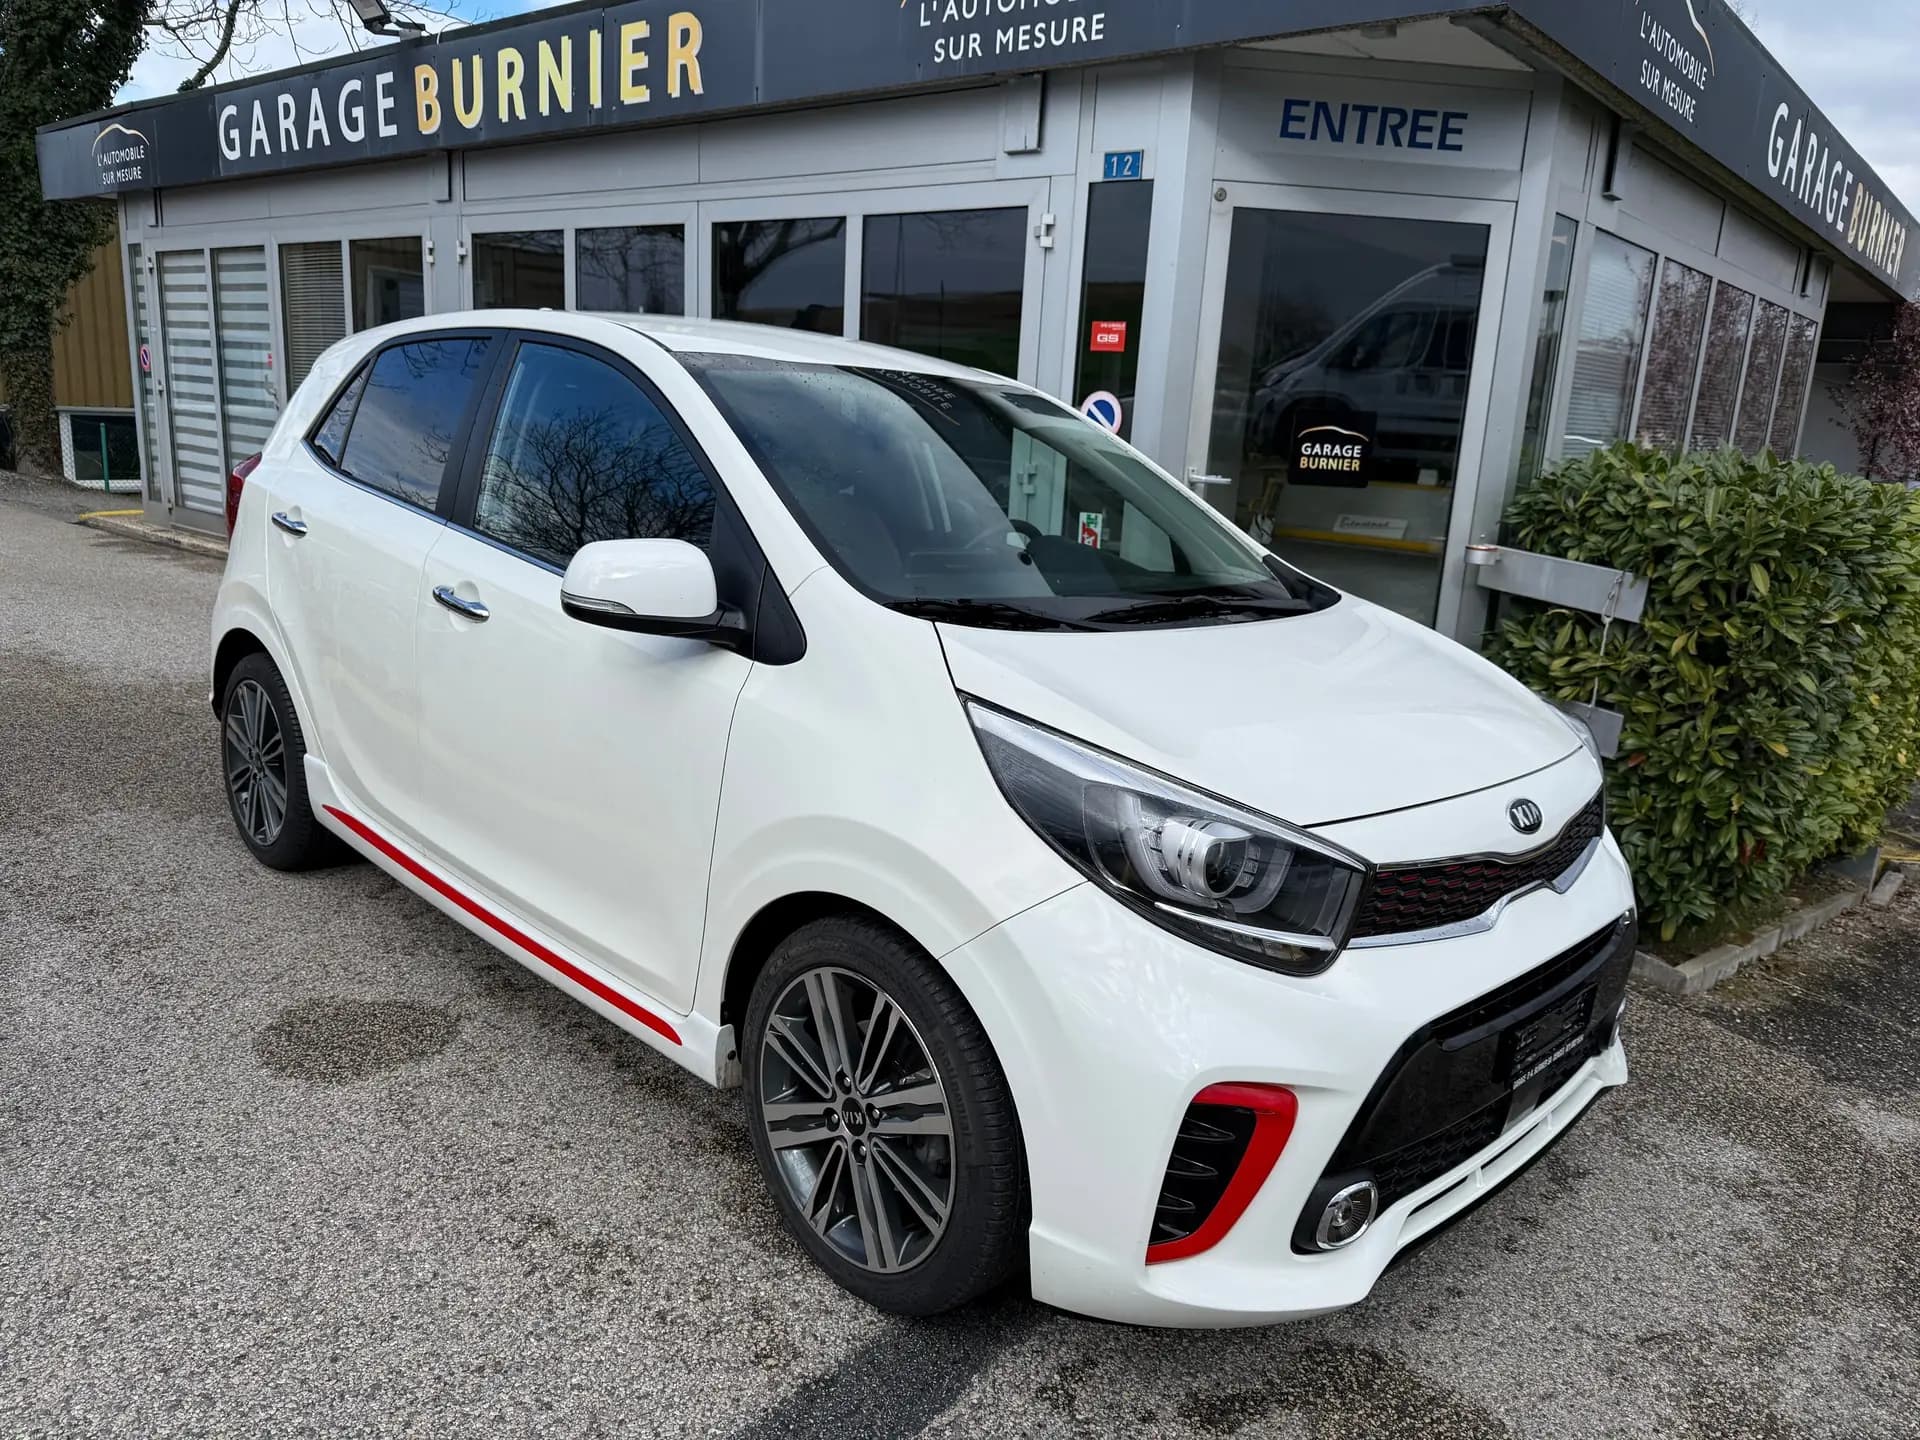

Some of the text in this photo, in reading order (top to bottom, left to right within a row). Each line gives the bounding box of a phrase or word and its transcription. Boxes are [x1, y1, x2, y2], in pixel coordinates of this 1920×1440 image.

[919, 0, 1079, 27] L'AUTO
[933, 12, 1105, 64] SUR MESURE
[1639, 10, 1708, 91] L'AUTOMOBILE
[218, 11, 704, 161] GARAGE BURNIER
[1640, 59, 1697, 123] SUR MESURE
[1279, 98, 1469, 152] ENTREE
[96, 144, 145, 167] L'AUTOMOBILE
[1111, 154, 1132, 177] 12
[102, 165, 143, 185] SUR MESURE
[1767, 102, 1906, 281] GARAGE BURNIER
[1301, 442, 1362, 458] GARAGE
[1299, 456, 1361, 472] BURNIER
[1511, 802, 1541, 828] KIA
[842, 1110, 863, 1125] KIA
